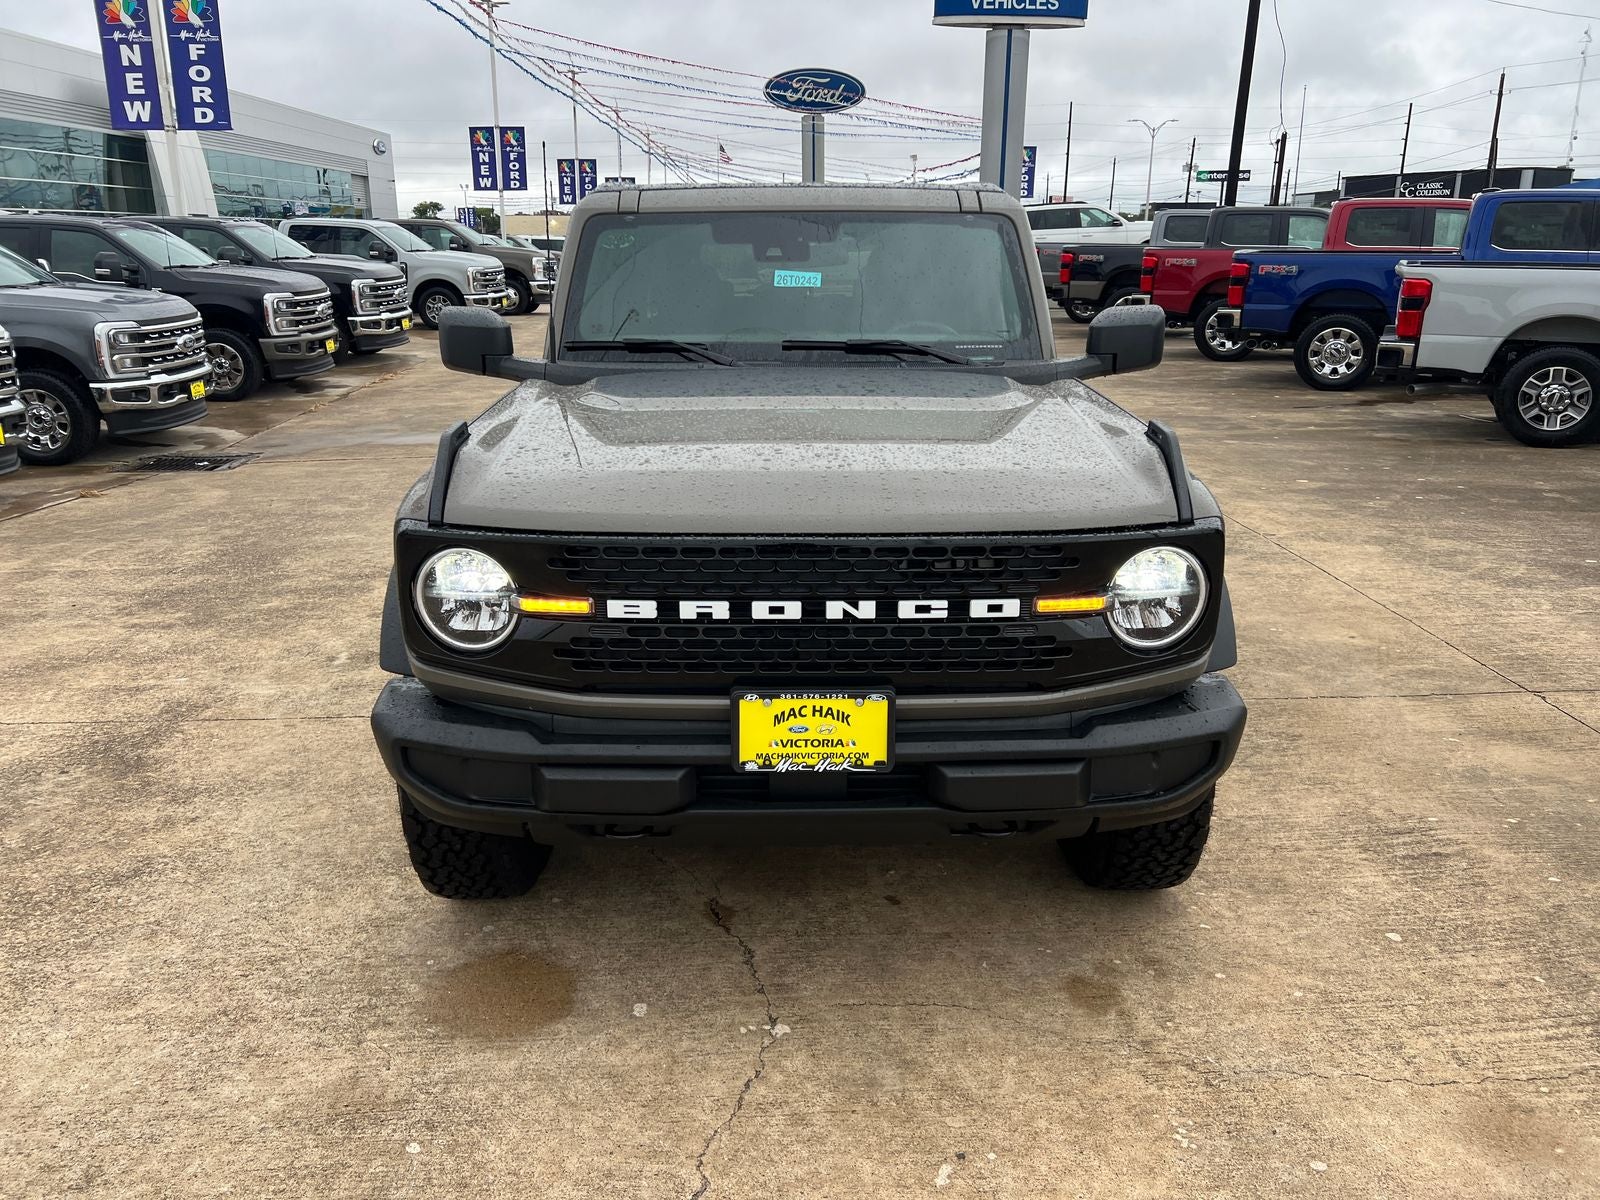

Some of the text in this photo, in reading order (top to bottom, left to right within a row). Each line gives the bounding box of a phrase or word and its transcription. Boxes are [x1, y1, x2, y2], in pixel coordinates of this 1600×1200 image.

[971, 0, 1060, 10] VEHICLES
[119, 44, 152, 122] NEW
[188, 43, 215, 124] FORD
[786, 76, 847, 105] Ford
[478, 152, 493, 188] NEW
[508, 152, 520, 189] FORD
[1200, 171, 1250, 179] enterse
[563, 176, 573, 203] NEW
[1020, 167, 1029, 197] FORD
[776, 274, 818, 286] 26T0242
[1258, 264, 1299, 276] FX4
[606, 599, 1021, 620] BRONCO
[773, 705, 852, 727] MAC HAIK
[780, 738, 845, 749] VICTORIA
[755, 752, 870, 760] MACHAIKVICTORIA.COM
[774, 758, 855, 773] Mac Haik
